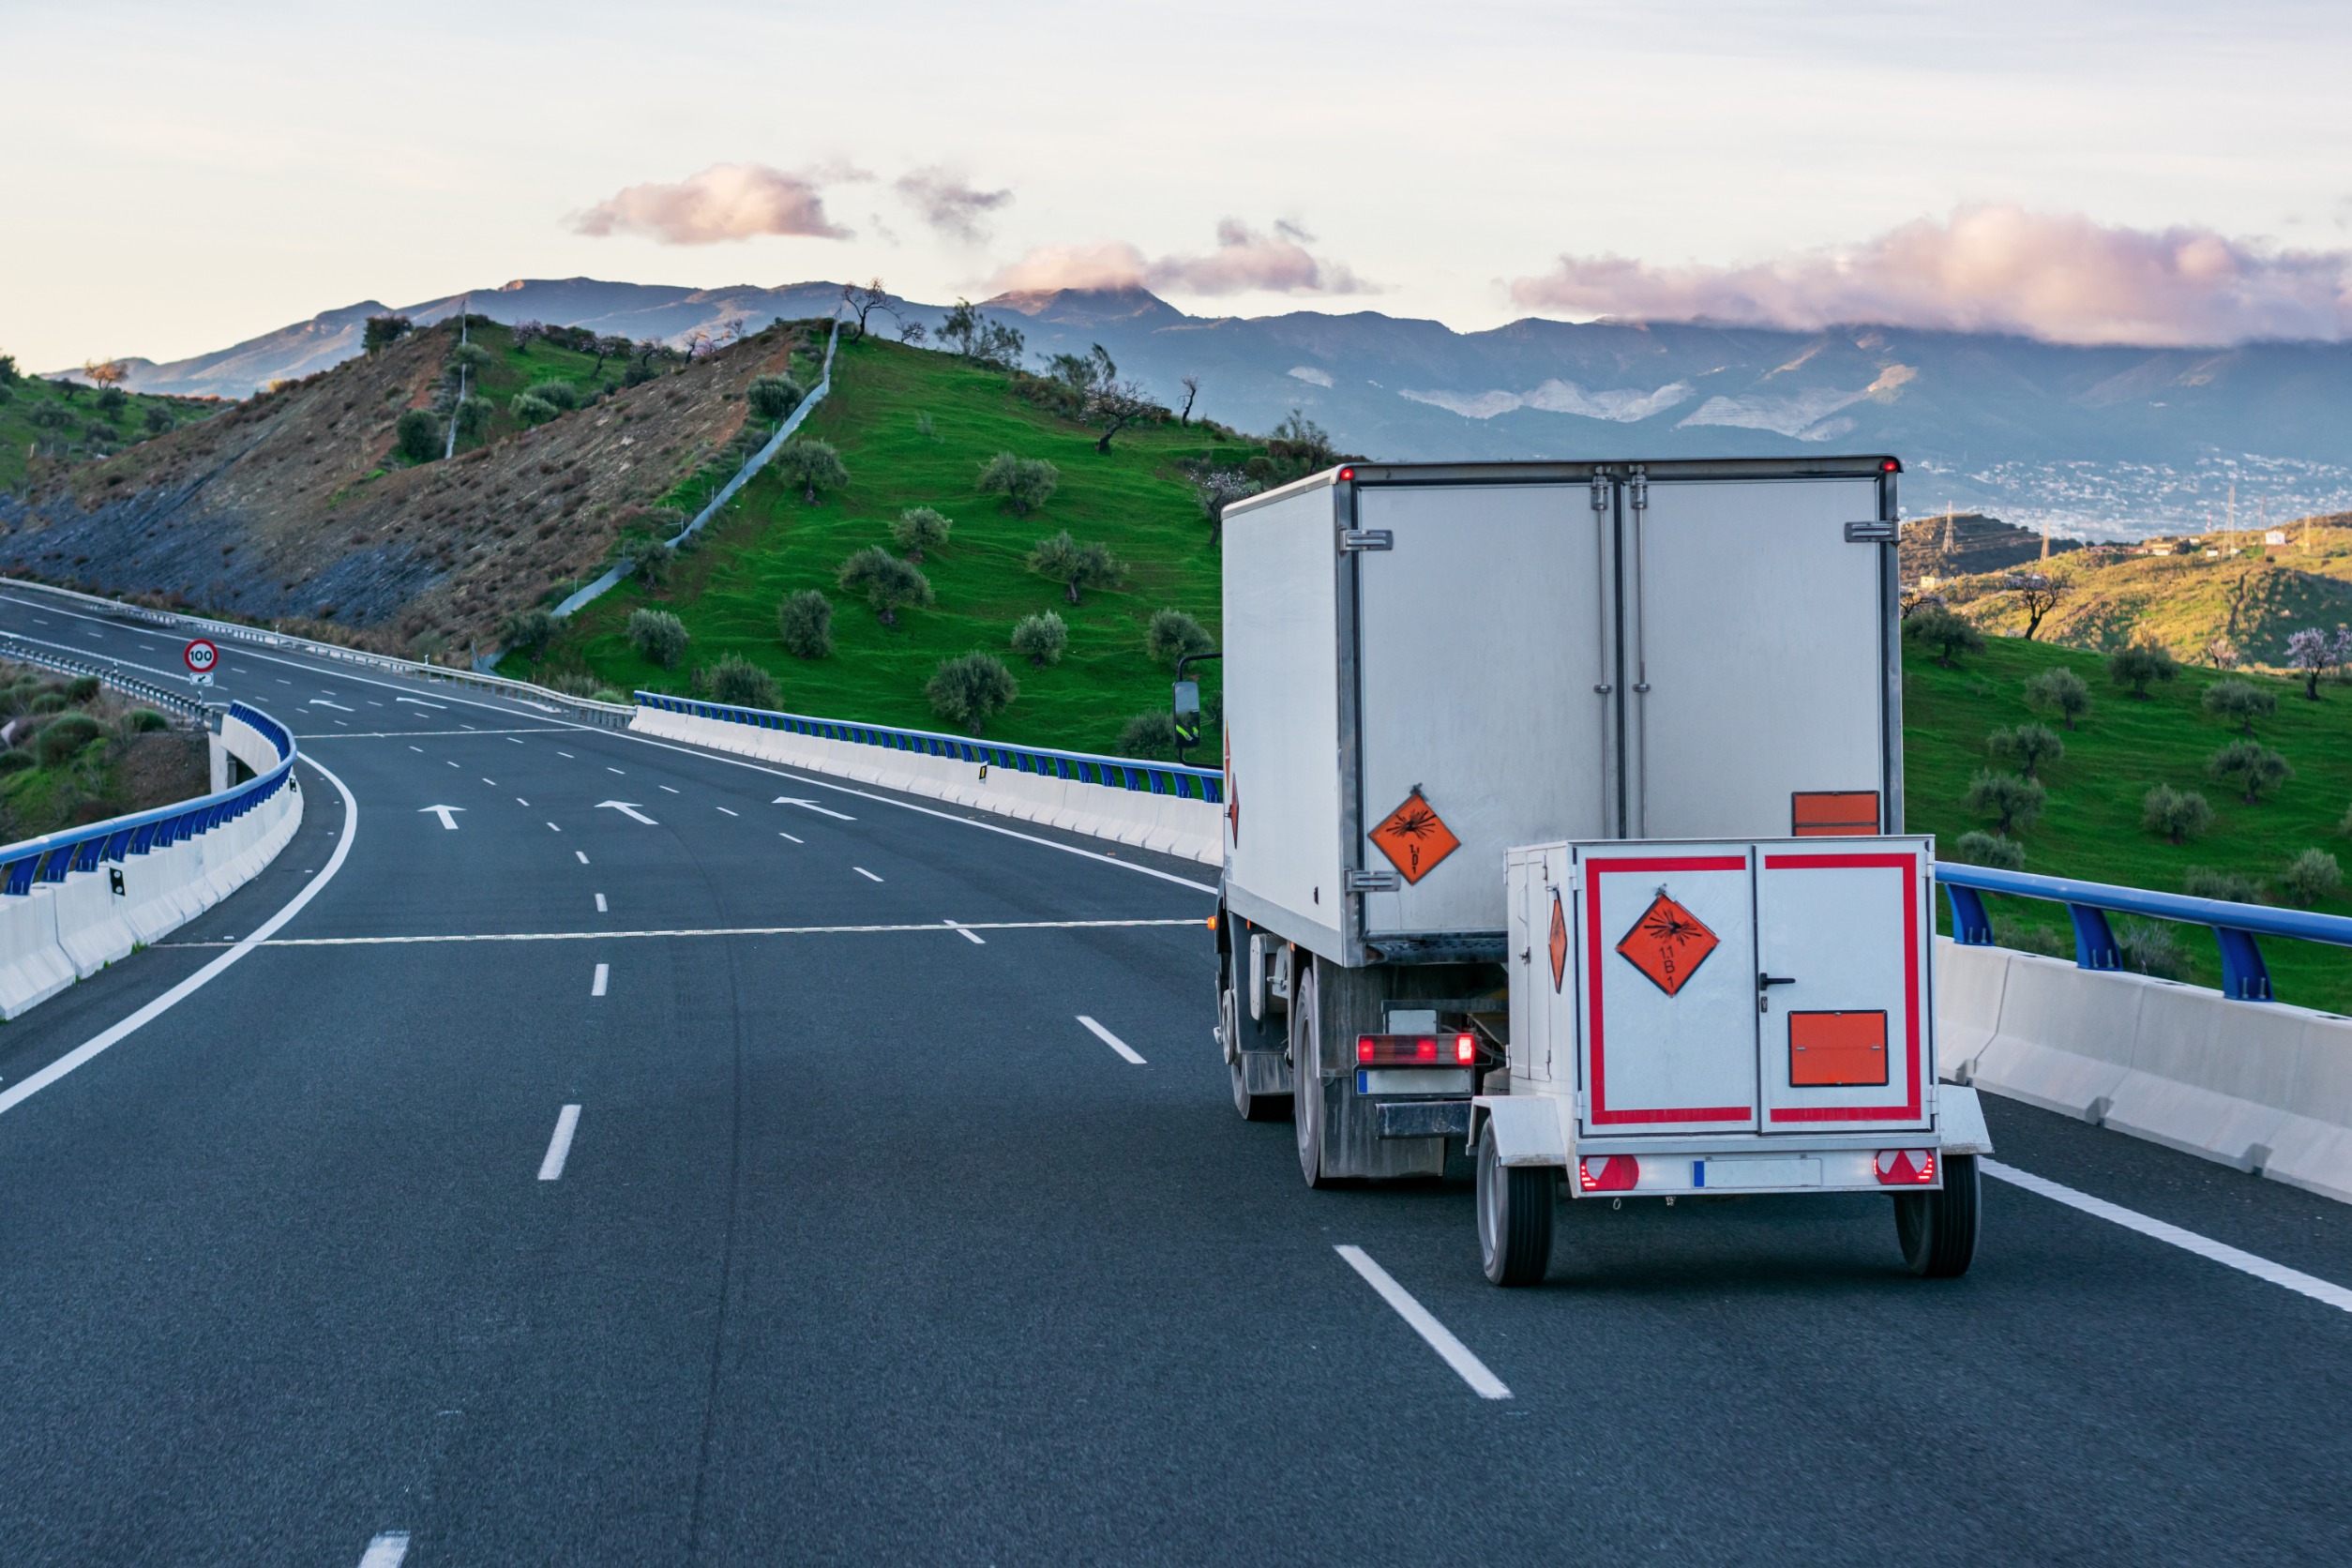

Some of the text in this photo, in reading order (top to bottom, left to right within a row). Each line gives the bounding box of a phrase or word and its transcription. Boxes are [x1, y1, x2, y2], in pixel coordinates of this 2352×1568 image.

[190, 651, 212, 661] 100
[1659, 945, 1673, 959] 1.1
[1664, 959, 1675, 973] B
[1666, 975, 1674, 988] 1
